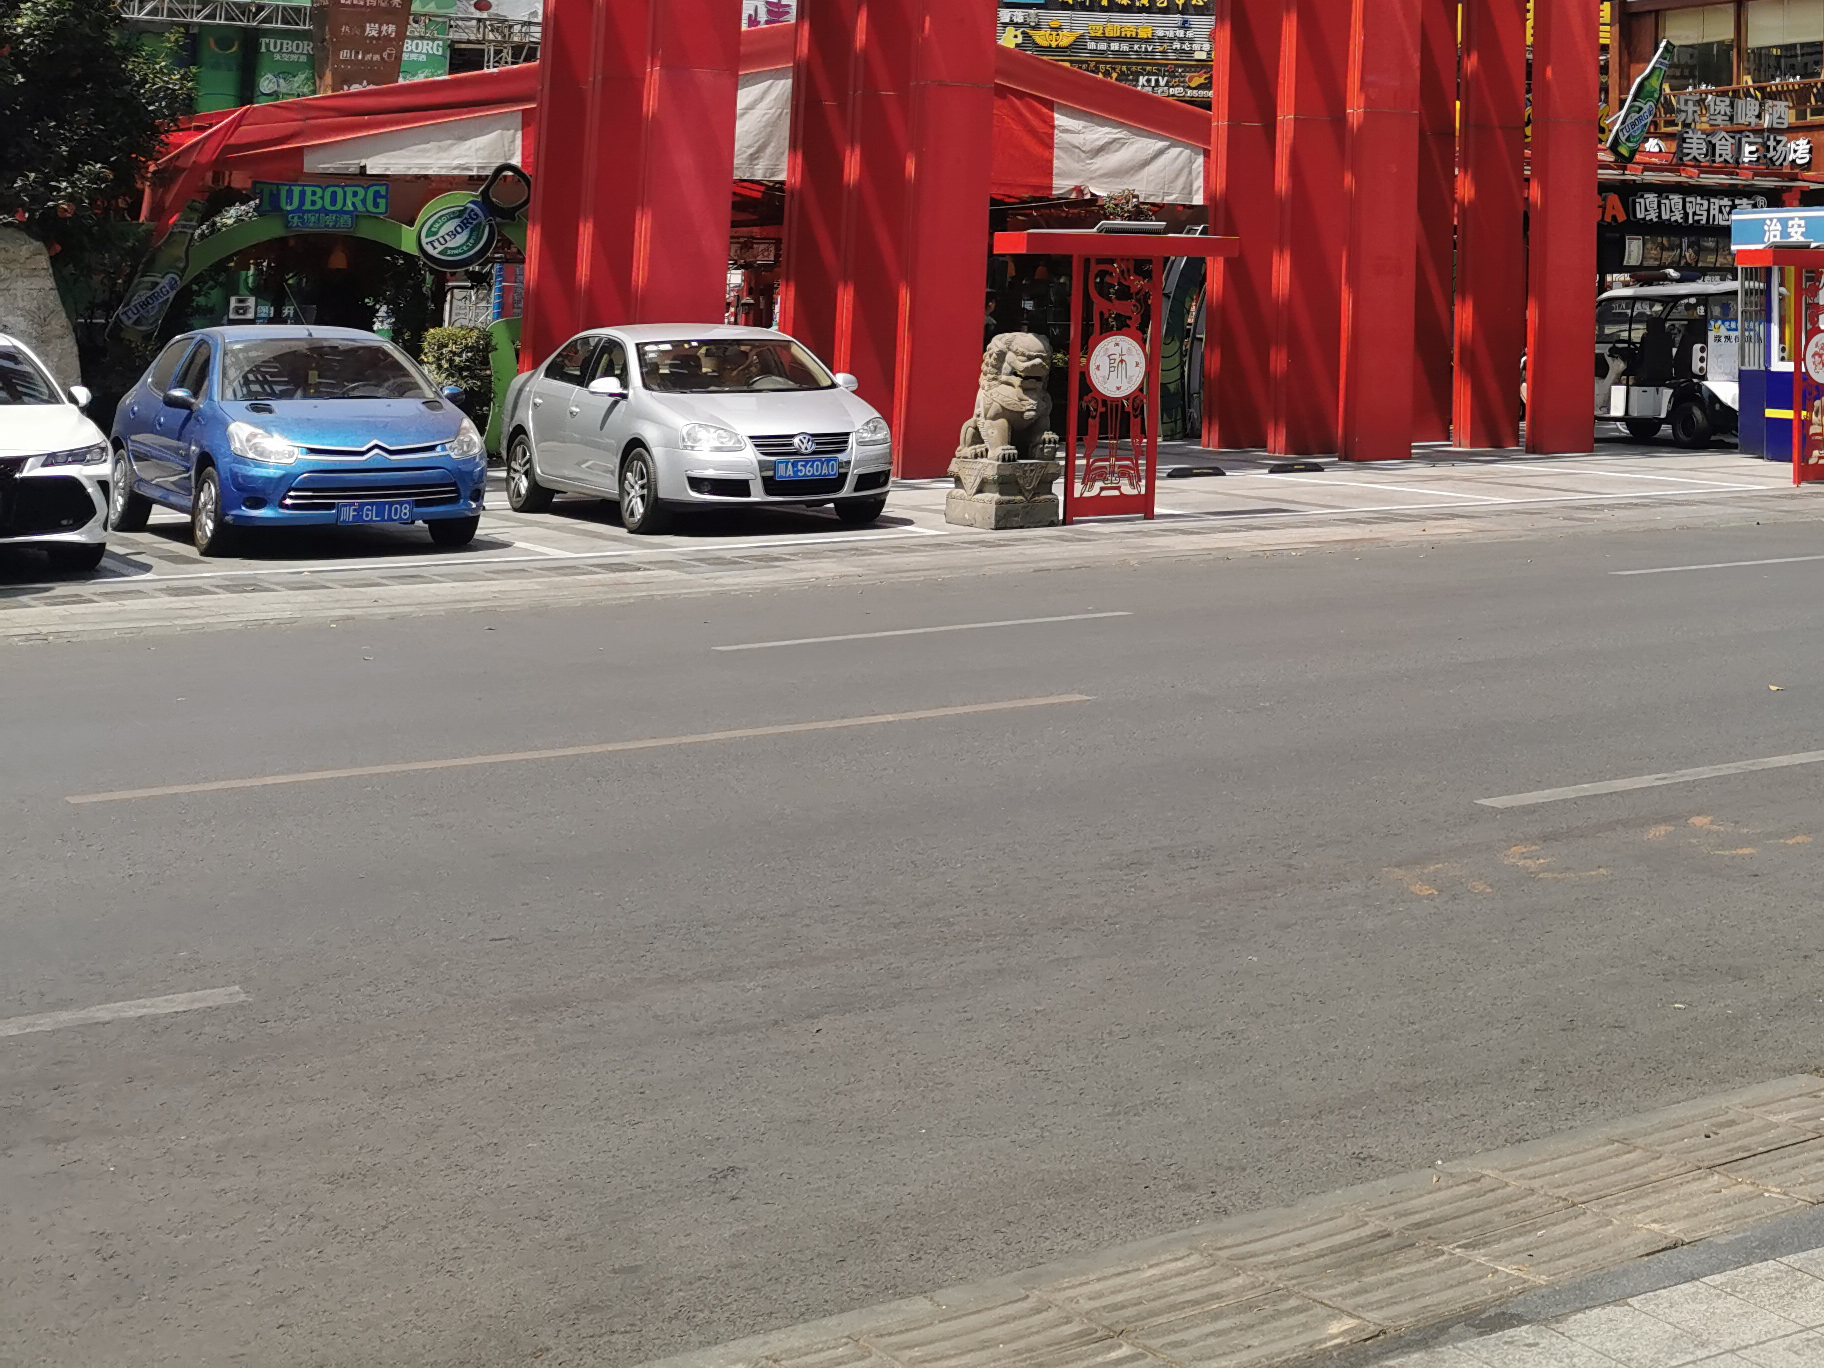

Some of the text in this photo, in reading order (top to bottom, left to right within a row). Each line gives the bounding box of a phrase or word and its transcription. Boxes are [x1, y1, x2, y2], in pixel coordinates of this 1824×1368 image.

[260, 37, 314, 54] TUBOR
[1138, 75, 1169, 87] KTV
[1678, 95, 1790, 129] 乐堡啤酒
[1682, 129, 1789, 167] 美食广场
[256, 183, 387, 213] TUBORG
[287, 213, 353, 229] 乐堡啤酒
[426, 207, 481, 251] TUBORG
[1763, 217, 1807, 242] 治安
[121, 285, 171, 321] TUBORG
